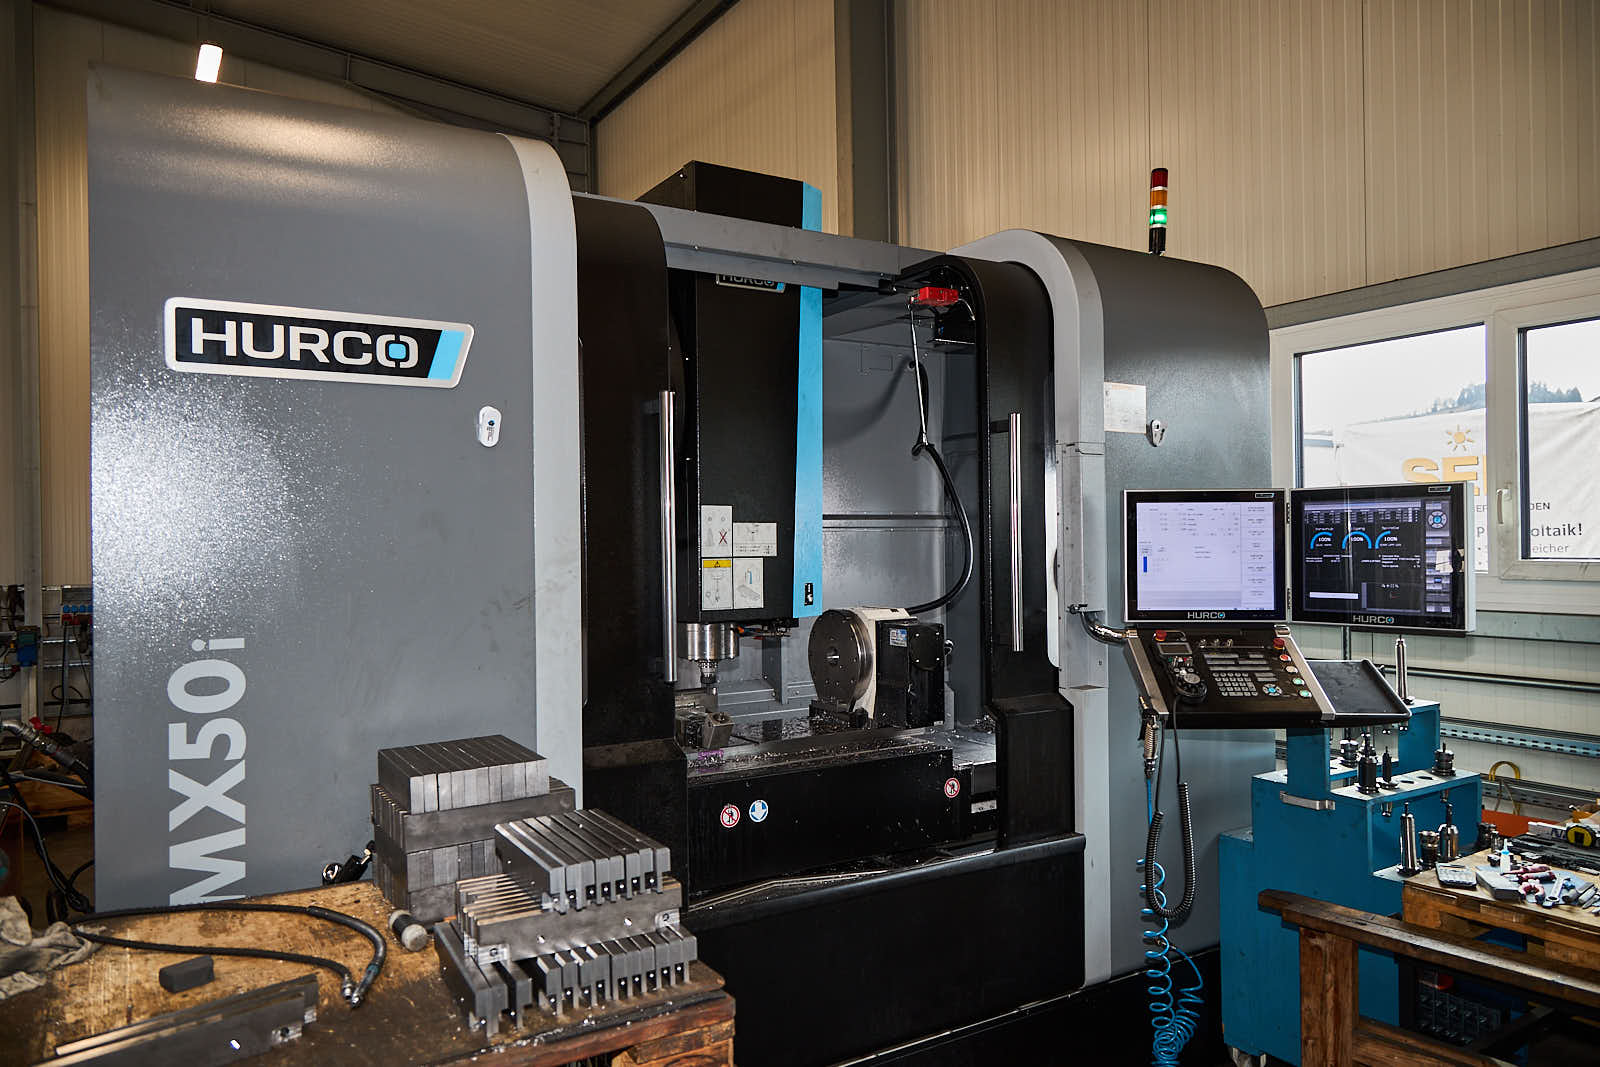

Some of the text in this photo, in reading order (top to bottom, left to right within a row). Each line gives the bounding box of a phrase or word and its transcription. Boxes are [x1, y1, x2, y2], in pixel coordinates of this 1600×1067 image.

[191, 317, 419, 369] HURCO
[1530, 522, 1582, 537] oltaik!
[1531, 543, 1569, 553] eicher
[1187, 611, 1226, 620] HURCO
[1352, 615, 1395, 624] HURCO
[167, 637, 247, 906] MX50i
